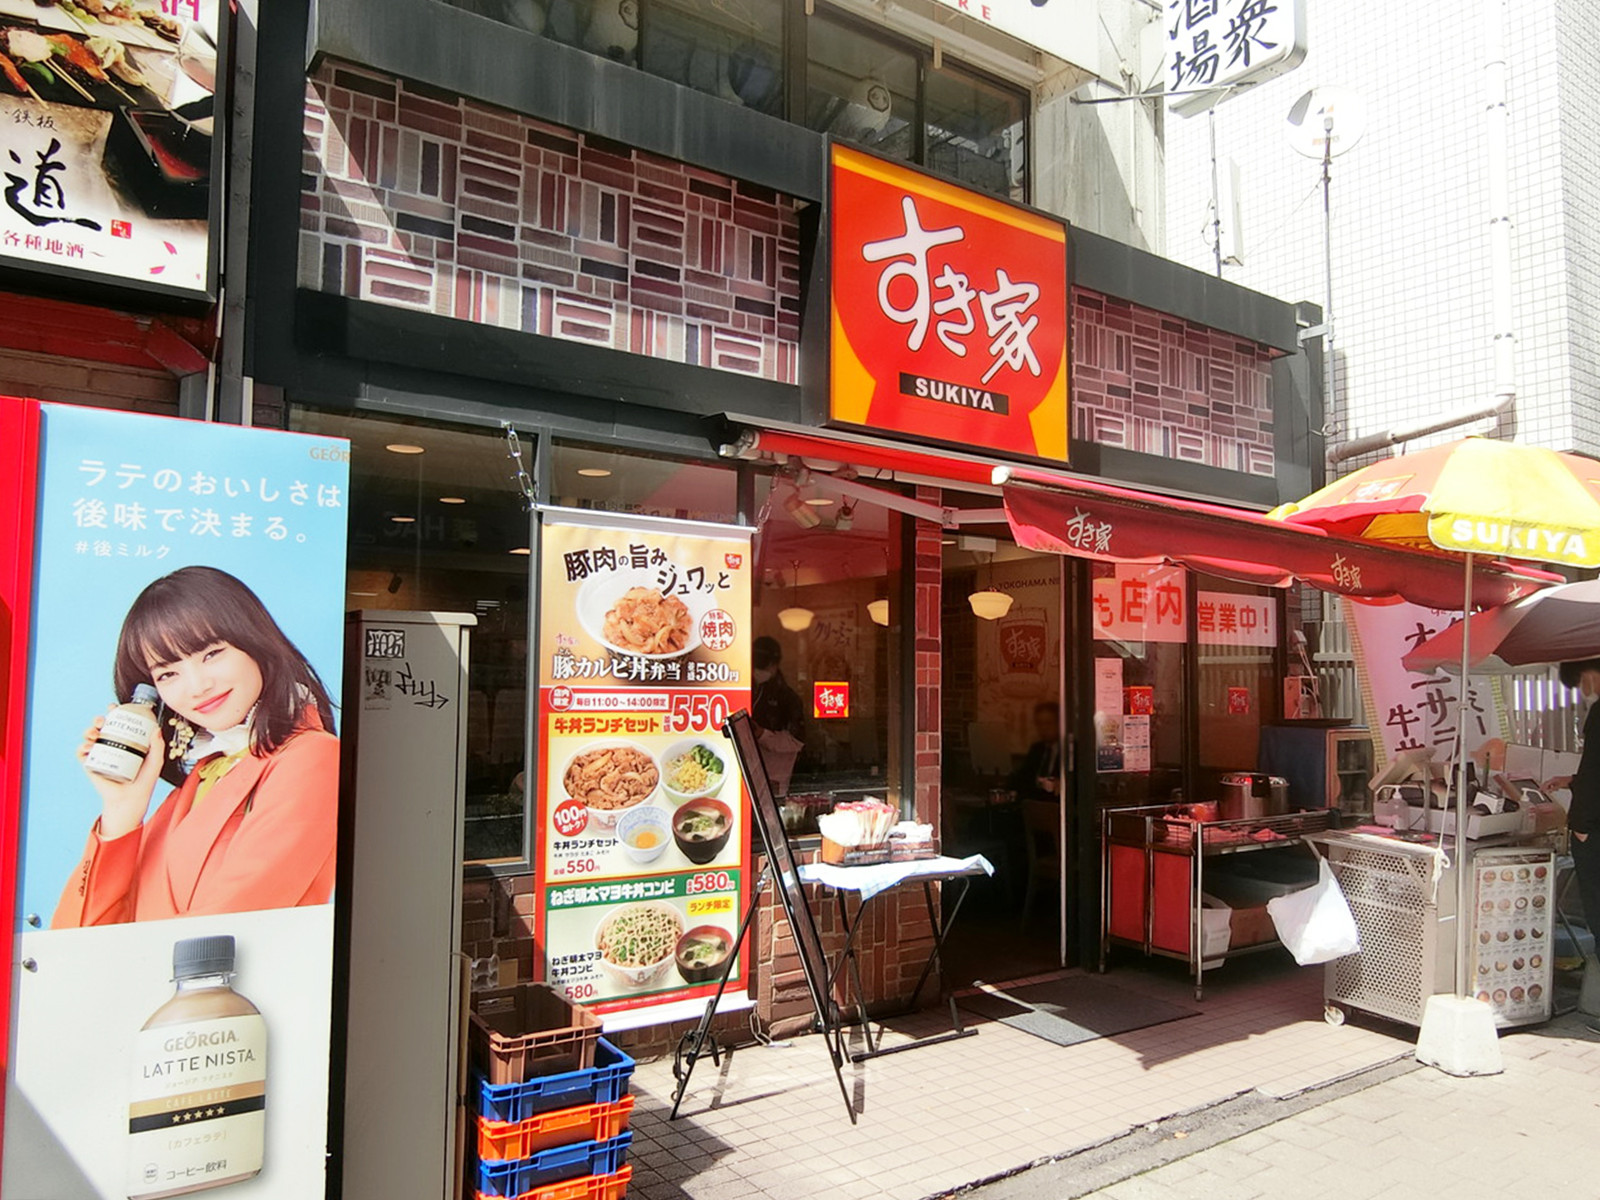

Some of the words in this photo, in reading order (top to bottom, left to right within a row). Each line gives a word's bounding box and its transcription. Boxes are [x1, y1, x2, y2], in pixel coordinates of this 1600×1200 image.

[4, 137, 103, 232] 道
[862, 195, 1042, 384] すき家
[915, 377, 995, 411] SUKIYA
[78, 458, 342, 508] ラテのおいしさは
[72, 497, 307, 544] 後味で決まる。
[1066, 506, 1113, 554] すき家
[74, 539, 172, 560] #後ミルク
[1451, 519, 1587, 558] SUKIYA
[563, 543, 668, 582] 豚肉の旨み
[1331, 553, 1362, 592] すき家
[656, 564, 731, 597] ジュワッと
[702, 621, 734, 638] 焼肉
[552, 655, 682, 681] 豚カルビ丼弁当
[695, 662, 739, 683] 580円
[554, 717, 659, 734] 牛丼ランチセット
[672, 694, 728, 733] 550
[553, 838, 619, 851] 牛丼ランチセット
[550, 878, 676, 906] ねぎ明太マヨ牛丼コンビ
[551, 951, 603, 966] ねぎ明太マヨ
[551, 963, 594, 978] 牛丼コンビ
[166, 1159, 228, 1181] コーヒー飲料
